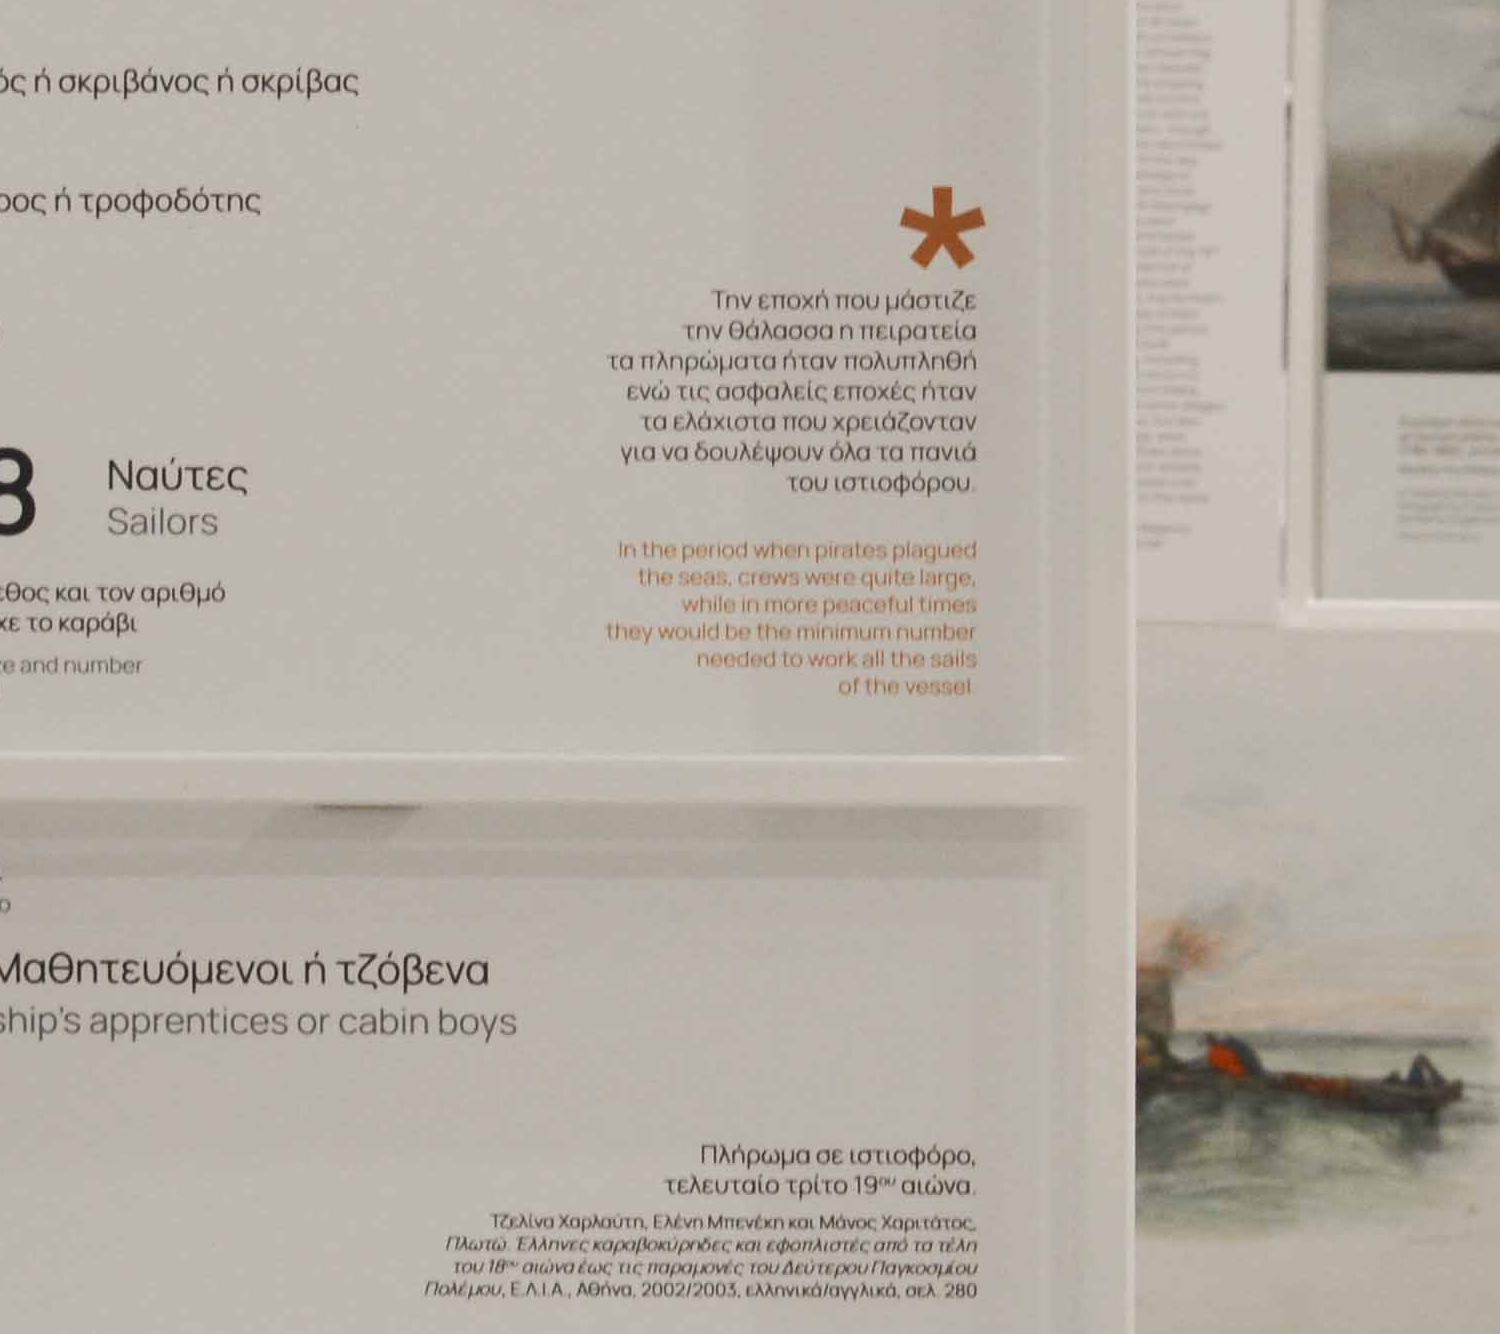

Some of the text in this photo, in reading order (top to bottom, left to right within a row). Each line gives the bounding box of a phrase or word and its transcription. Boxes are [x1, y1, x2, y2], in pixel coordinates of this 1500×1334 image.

[34, 68, 51, 93] ή
[58, 67, 209, 100] σκριβάνος
[217, 67, 234, 92] ή
[242, 67, 358, 100] σκρίβας
[55, 187, 71, 212] ή
[79, 186, 260, 219] τροφοδότης
[713, 289, 976, 315] Την εποχή που μάστιζε
[685, 319, 977, 346] την θάλασσα η πειρατεία
[608, 349, 977, 376] τα πληρώματα ήταν πολυπληθή
[627, 380, 977, 406] ενώ τις ασφαλείς εποχές ήταν
[109, 457, 247, 495] Ναύτες
[108, 507, 218, 536] Sailors
[56, 587, 90, 602] και
[97, 586, 135, 602] τον
[141, 581, 225, 608] αριθμό
[27, 617, 53, 632] το
[59, 611, 137, 638] καράβι
[606, 622, 976, 645] they would be the minimum number
[20, 656, 58, 674] and
[64, 656, 142, 674] number
[305, 951, 326, 984] ή
[336, 951, 488, 994] τζόβενα
[89, 1008, 288, 1043] apprentices
[297, 1013, 330, 1035] or
[339, 1008, 429, 1035] cabin
[439, 1008, 517, 1043] boys
[701, 1144, 810, 1170] Πλήρωμα
[816, 1149, 843, 1165] σε
[665, 1174, 780, 1195] τελευταίο
[786, 1174, 848, 1201] τρίτο
